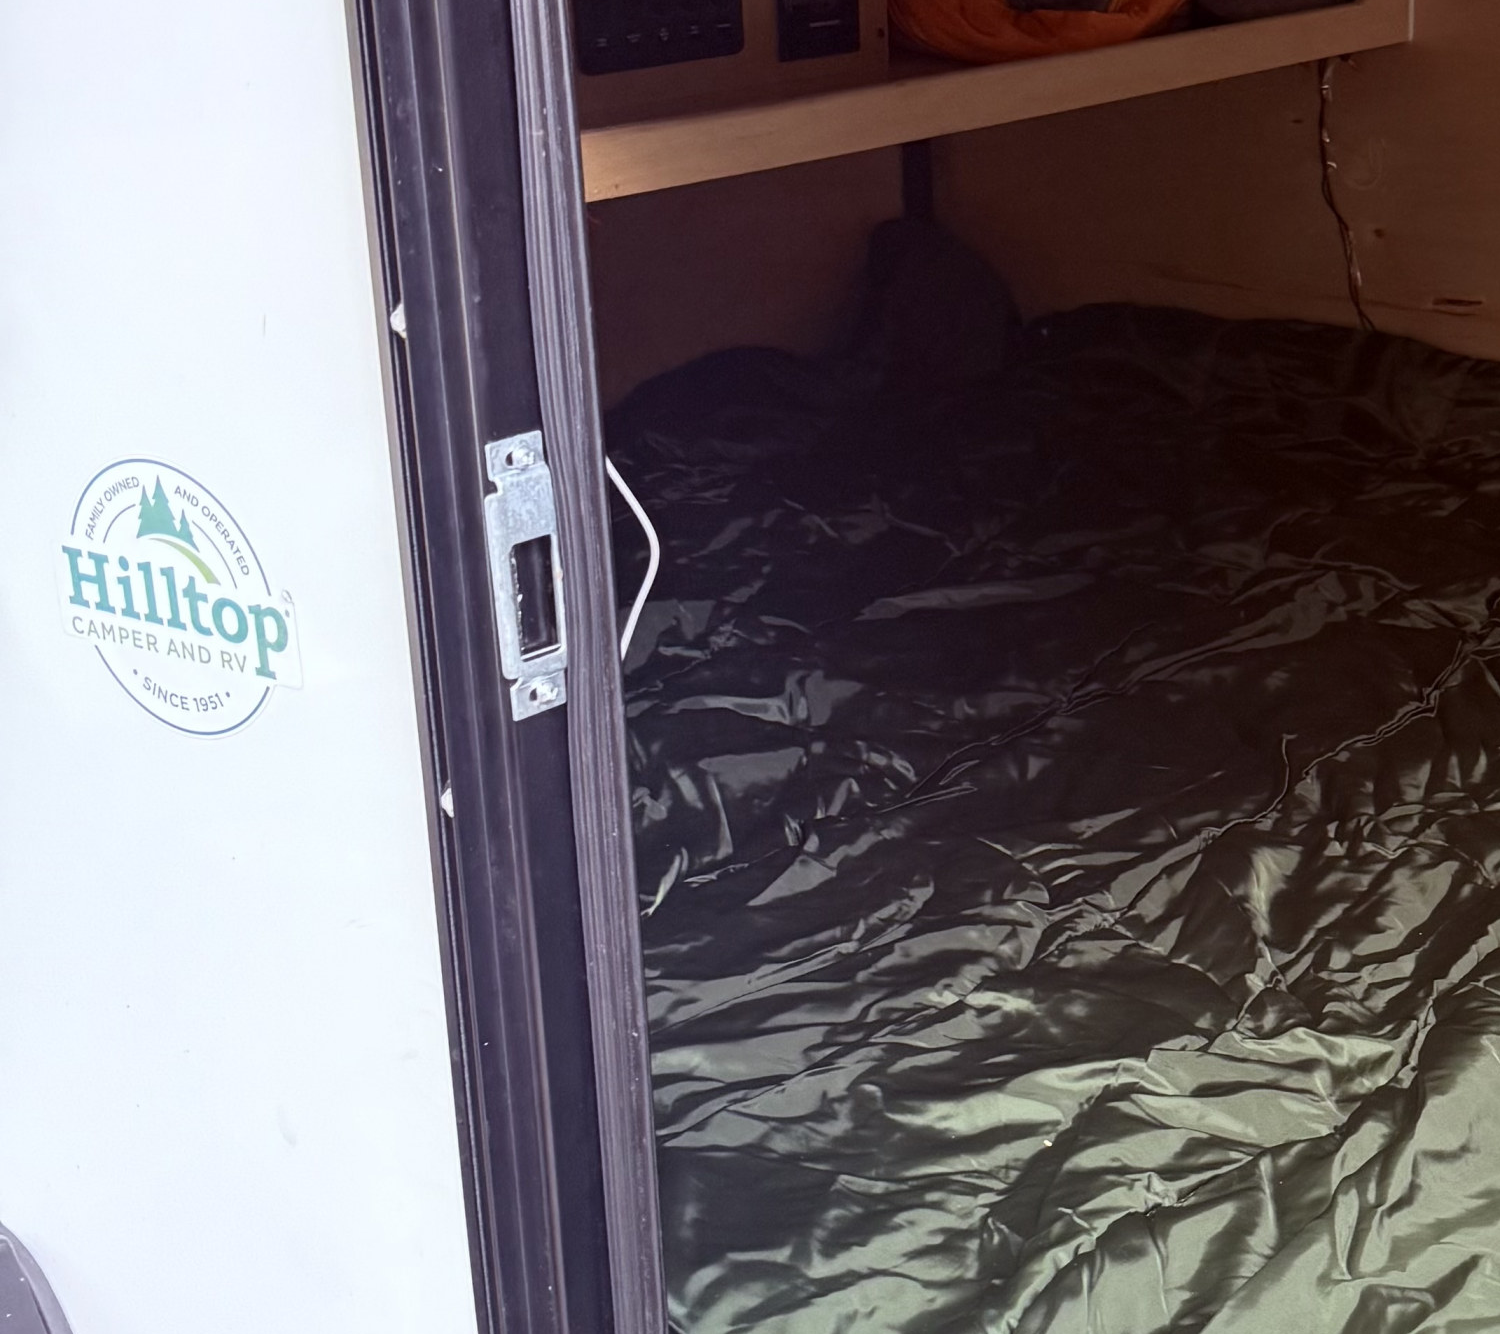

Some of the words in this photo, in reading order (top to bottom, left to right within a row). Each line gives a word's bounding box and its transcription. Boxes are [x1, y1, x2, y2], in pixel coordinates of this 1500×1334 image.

[85, 497, 105, 541] FAMILY
[103, 476, 140, 502] OWNED
[174, 485, 199, 507] AND
[201, 505, 250, 576] OPERATED
[61, 544, 288, 680] Hilltop
[72, 616, 159, 654] CAMPER
[167, 638, 211, 664] AND
[220, 650, 247, 673] RV
[142, 676, 190, 711] SINCE
[193, 693, 224, 712] 1951
